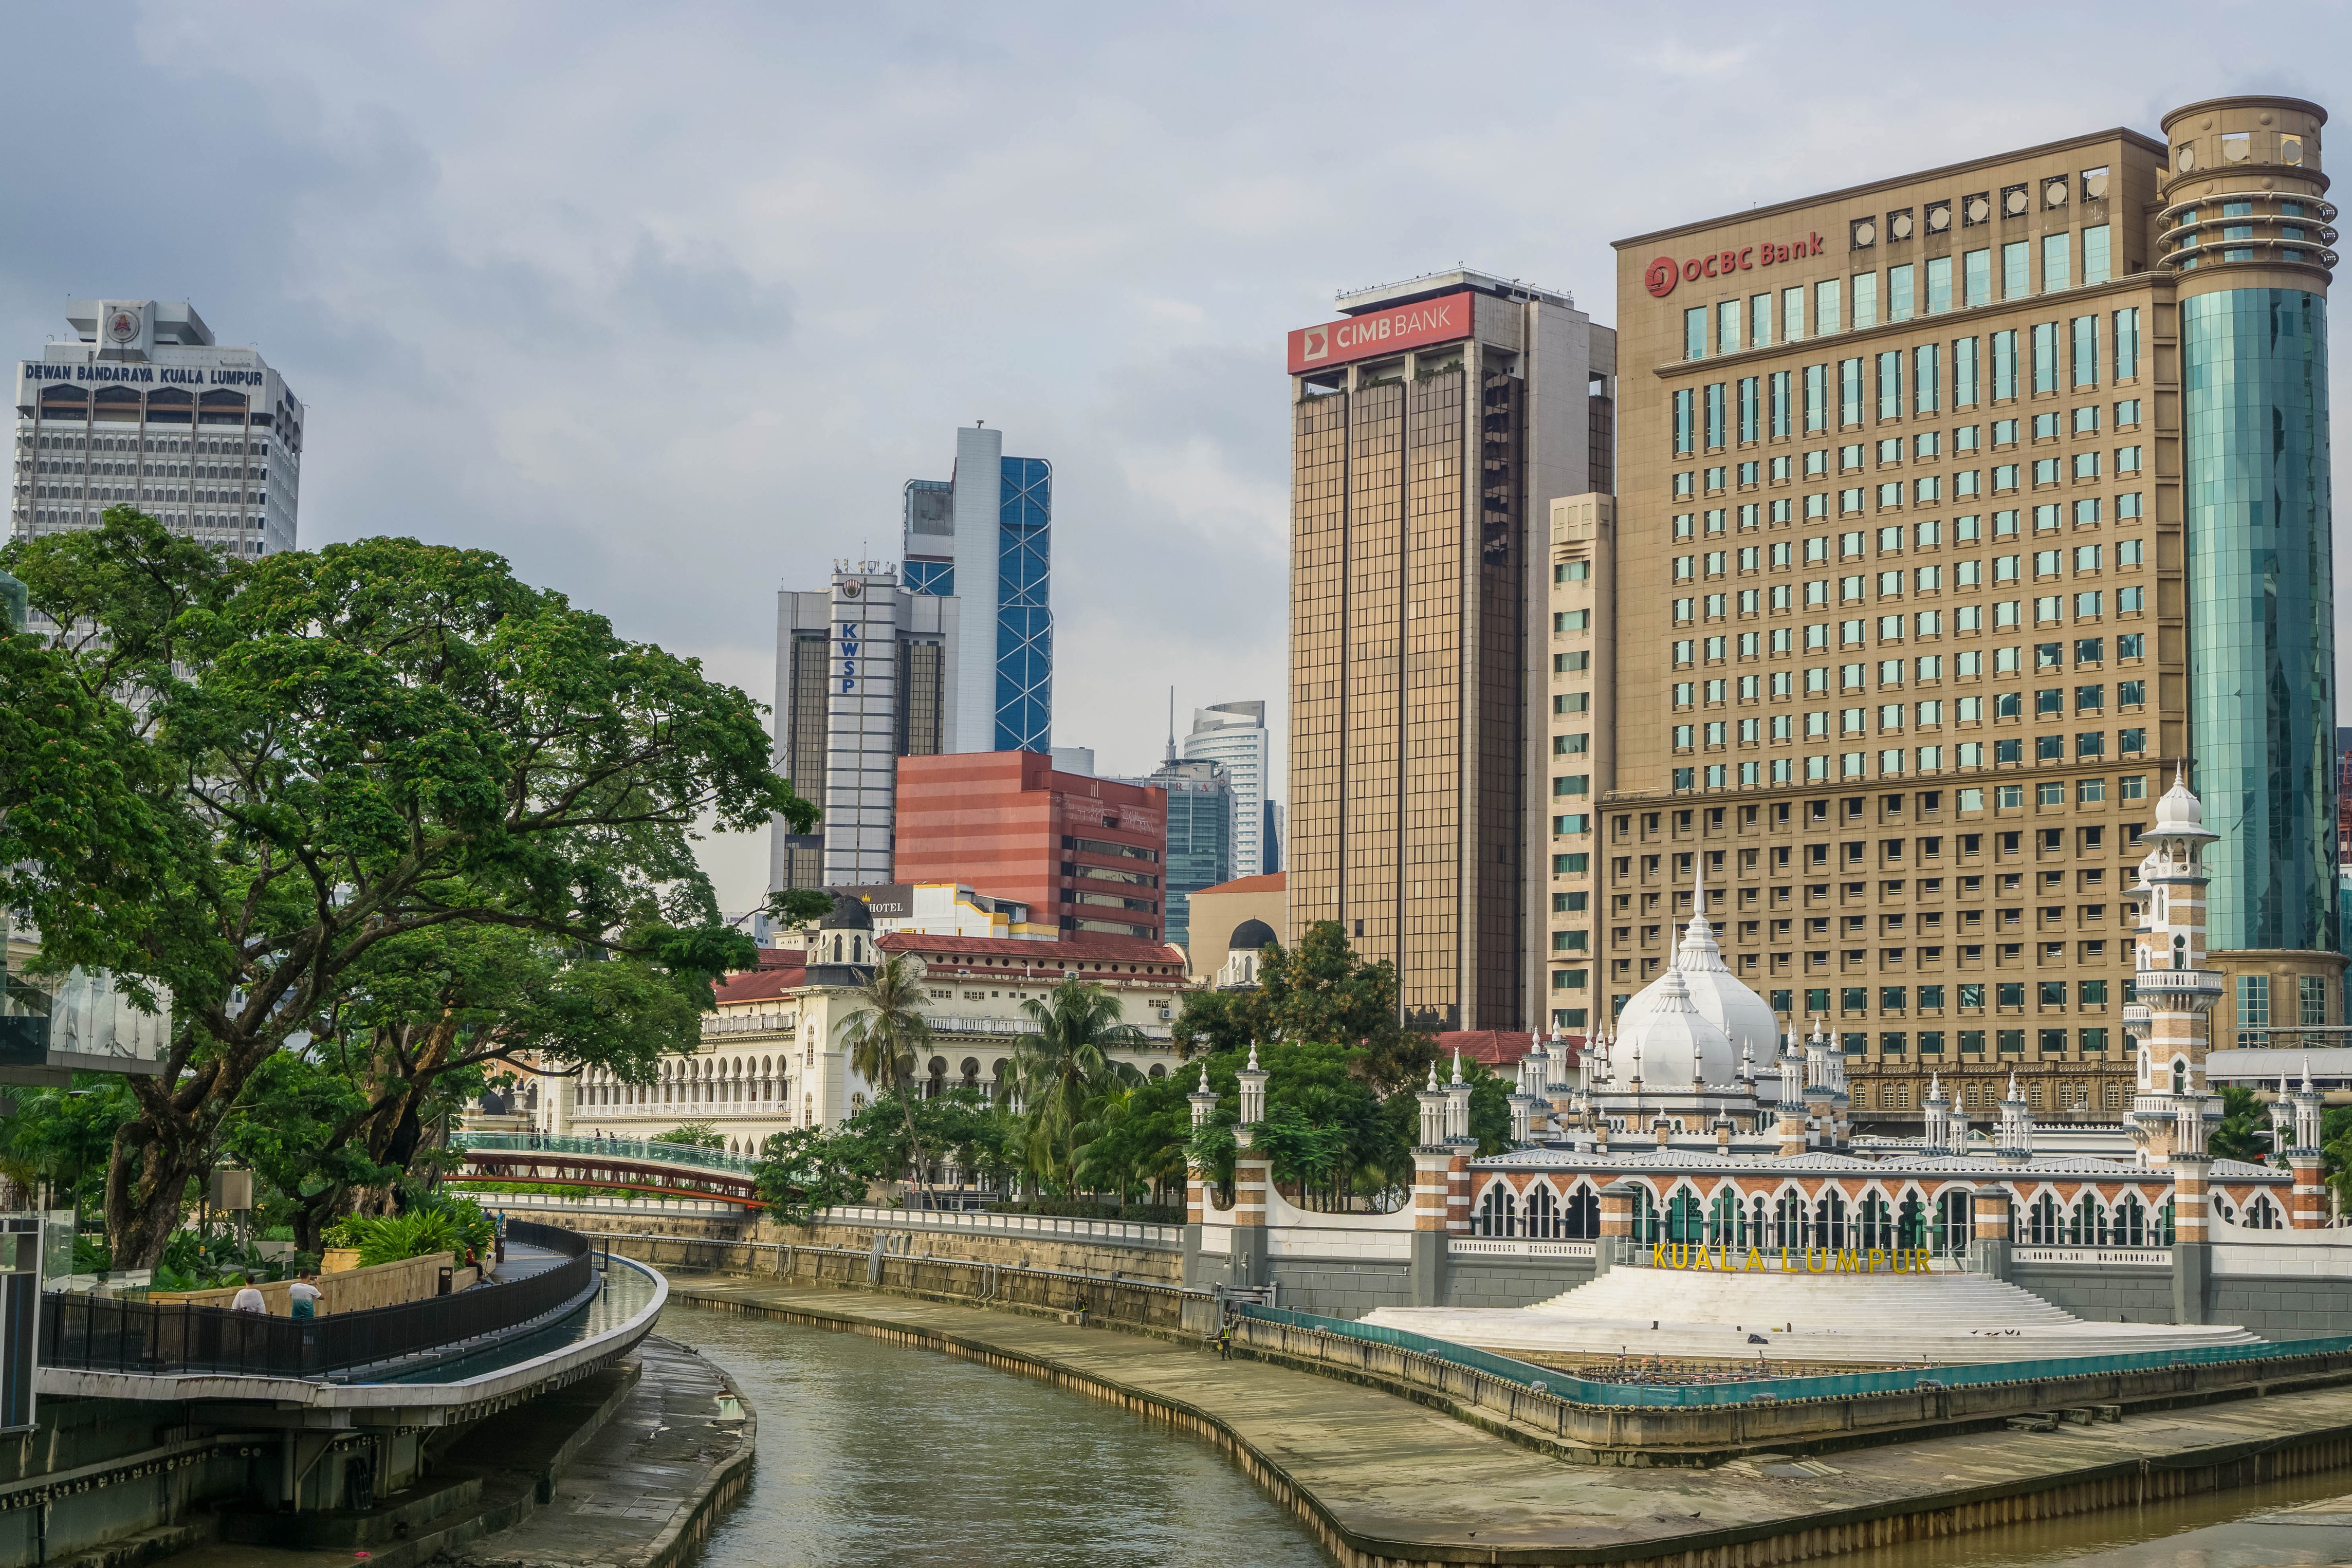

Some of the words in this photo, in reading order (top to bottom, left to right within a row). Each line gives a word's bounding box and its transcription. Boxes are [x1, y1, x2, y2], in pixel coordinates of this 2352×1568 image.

[1682, 247, 1752, 281] OCBC
[1760, 231, 1824, 265] Bank
[1336, 318, 1390, 348] CIMB
[1394, 305, 1451, 337] BANK
[25, 364, 71, 380] DEWAN
[77, 366, 154, 383] BANDARAYA
[160, 368, 204, 384] KUALA
[210, 370, 263, 386] LUMPUR
[841, 623, 859, 693] KWSP
[869, 902, 904, 913] HOTEL
[1653, 1242, 1766, 1272] KUALA
[1781, 1246, 1932, 1275] LUMPUR
